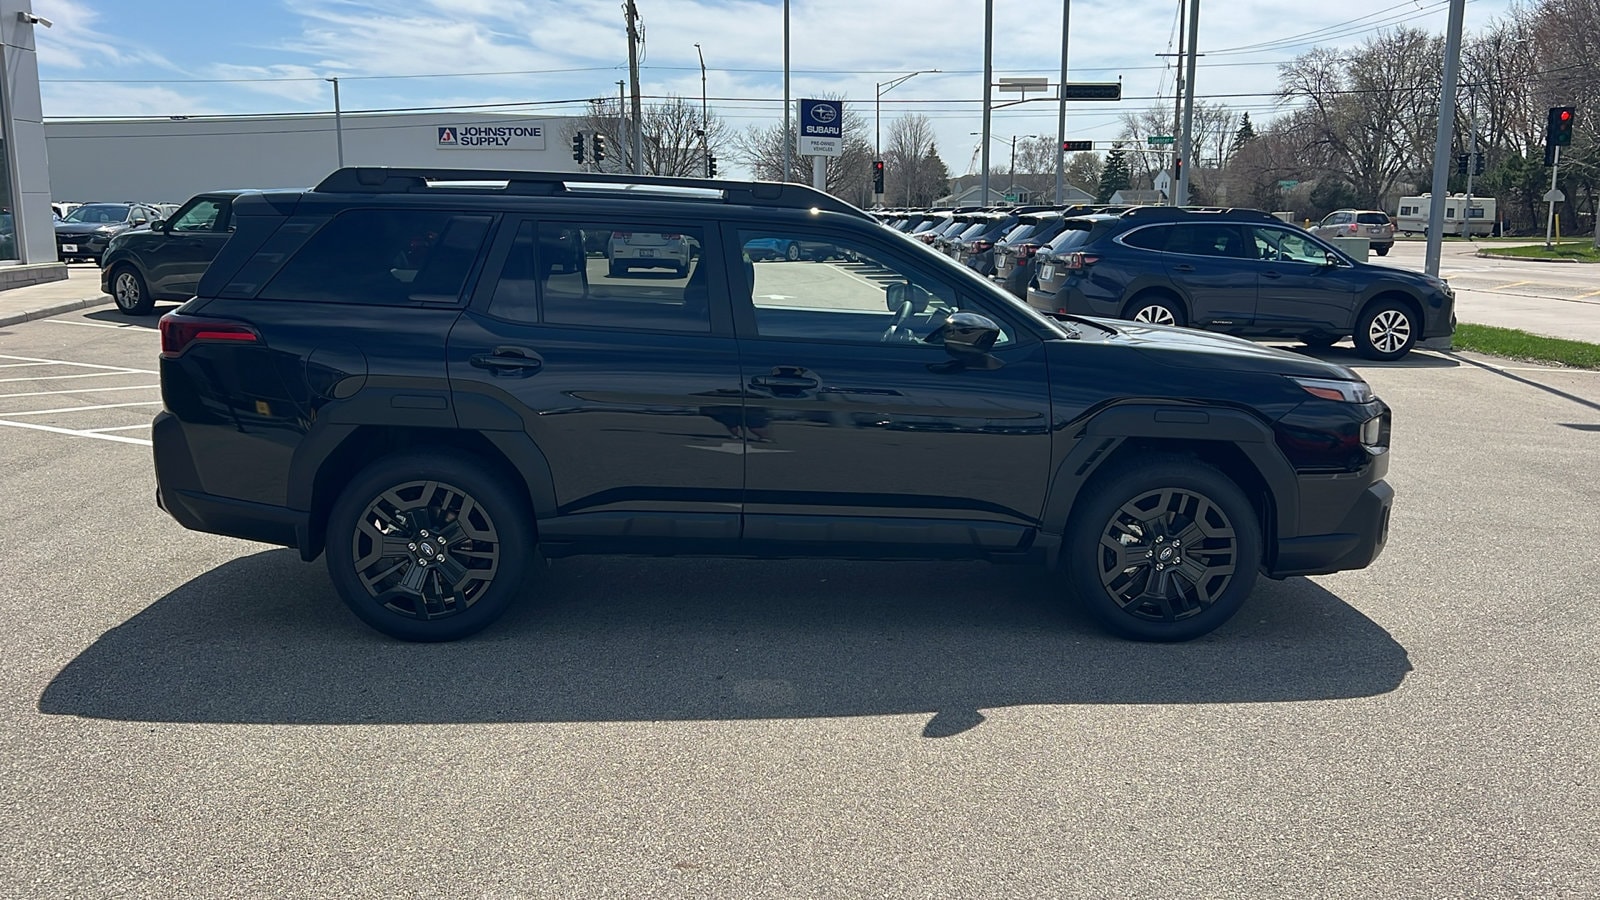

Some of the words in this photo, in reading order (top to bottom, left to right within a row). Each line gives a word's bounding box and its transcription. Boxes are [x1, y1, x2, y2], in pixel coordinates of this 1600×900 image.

[460, 127, 541, 137] JOHNSTONE
[806, 125, 839, 134] SUBARU
[461, 137, 511, 146] SUPPLY
